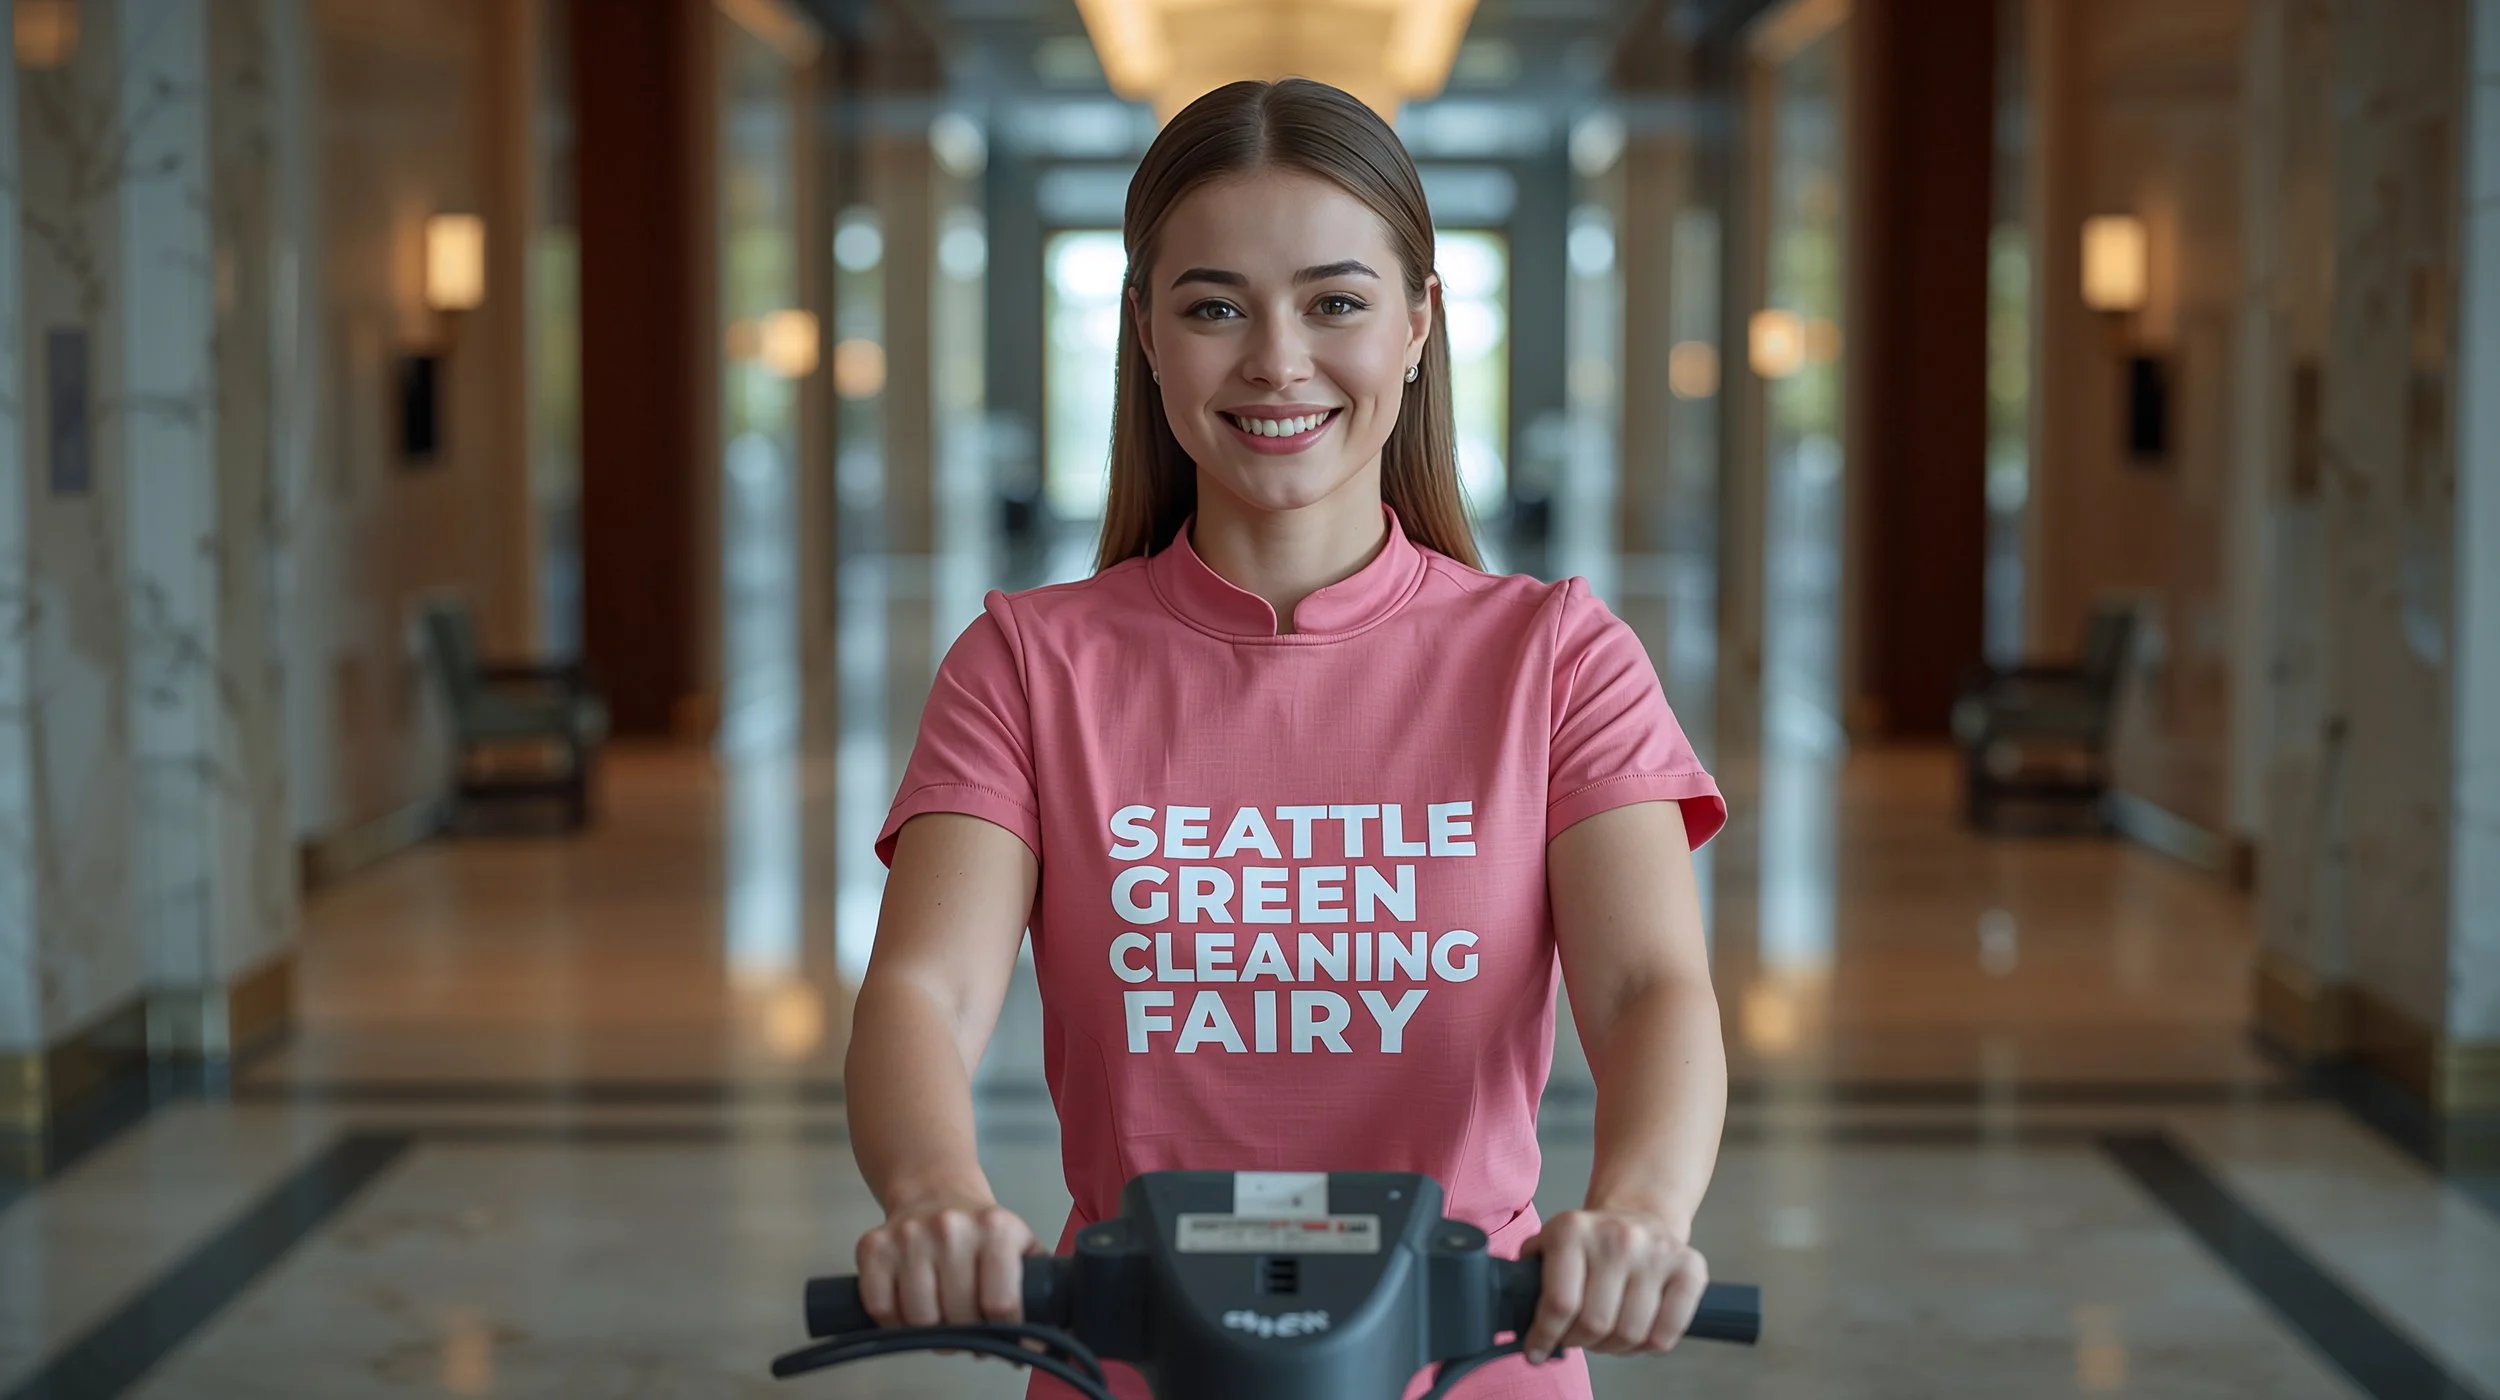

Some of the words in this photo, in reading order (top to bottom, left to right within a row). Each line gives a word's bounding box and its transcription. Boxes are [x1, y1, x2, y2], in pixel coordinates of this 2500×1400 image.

[1108, 801, 1477, 861] SEATTLE
[1111, 864, 1417, 925] GREEN
[1108, 930, 1480, 984] CLEANING
[1123, 989, 1429, 1054] FAIRY
